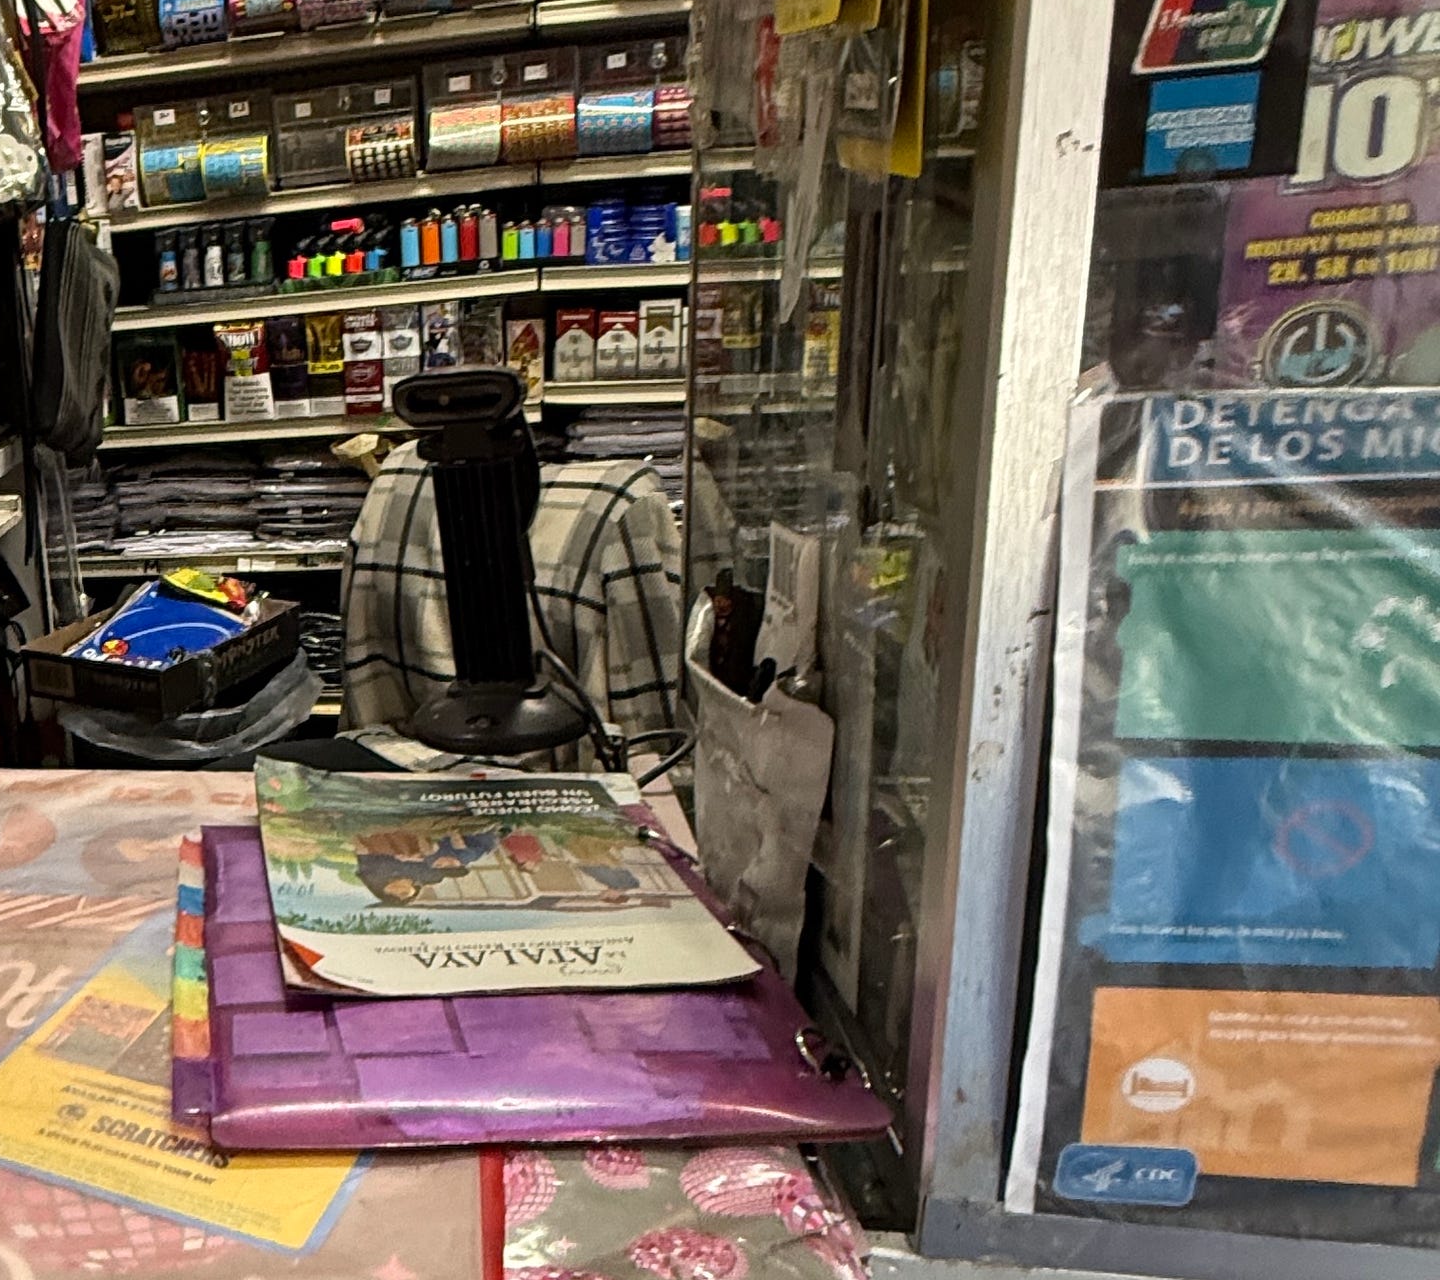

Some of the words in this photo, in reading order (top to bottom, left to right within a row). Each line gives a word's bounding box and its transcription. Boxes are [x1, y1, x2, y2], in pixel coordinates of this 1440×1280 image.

[1168, 434, 1232, 468] DE
[1248, 427, 1346, 464] LOS
[410, 944, 603, 969] ATALAYA
[91, 1114, 231, 1170] SCRATCHERS
